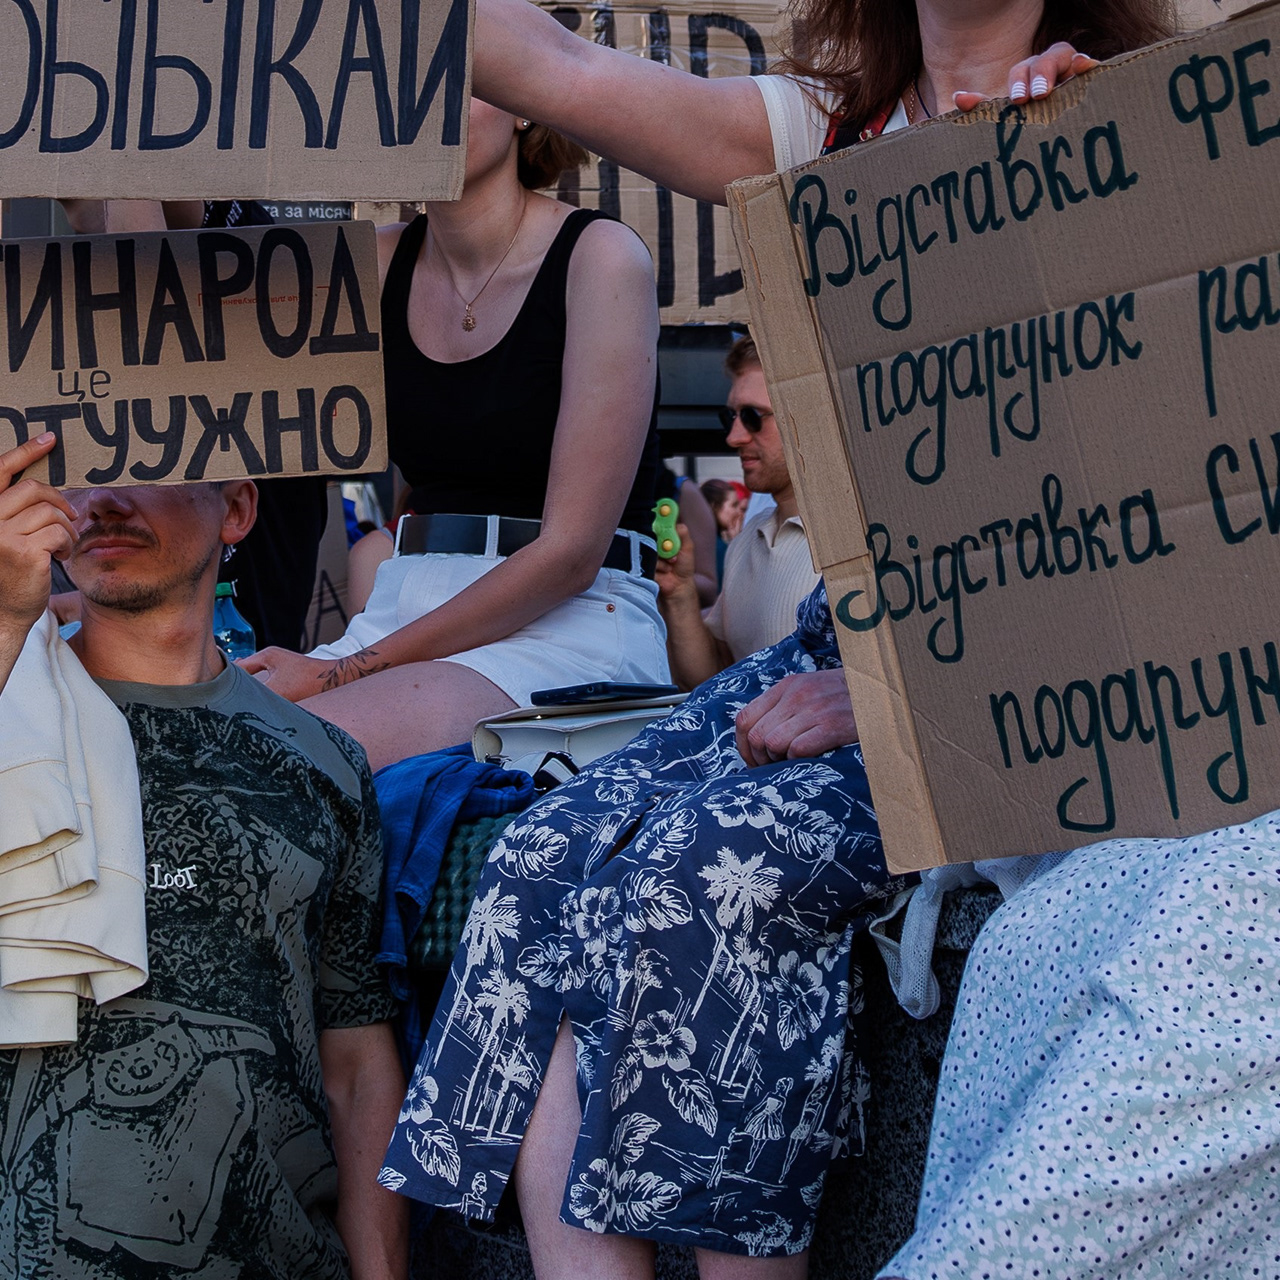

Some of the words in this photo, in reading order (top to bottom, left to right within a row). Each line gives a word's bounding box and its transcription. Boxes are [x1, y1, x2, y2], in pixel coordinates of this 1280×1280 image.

[285, 206, 302, 218] за
[789, 104, 1138, 331] Відставка
[58, 368, 112, 403] це
[855, 292, 1143, 485] подарунок
[835, 474, 1175, 664] Відставка
